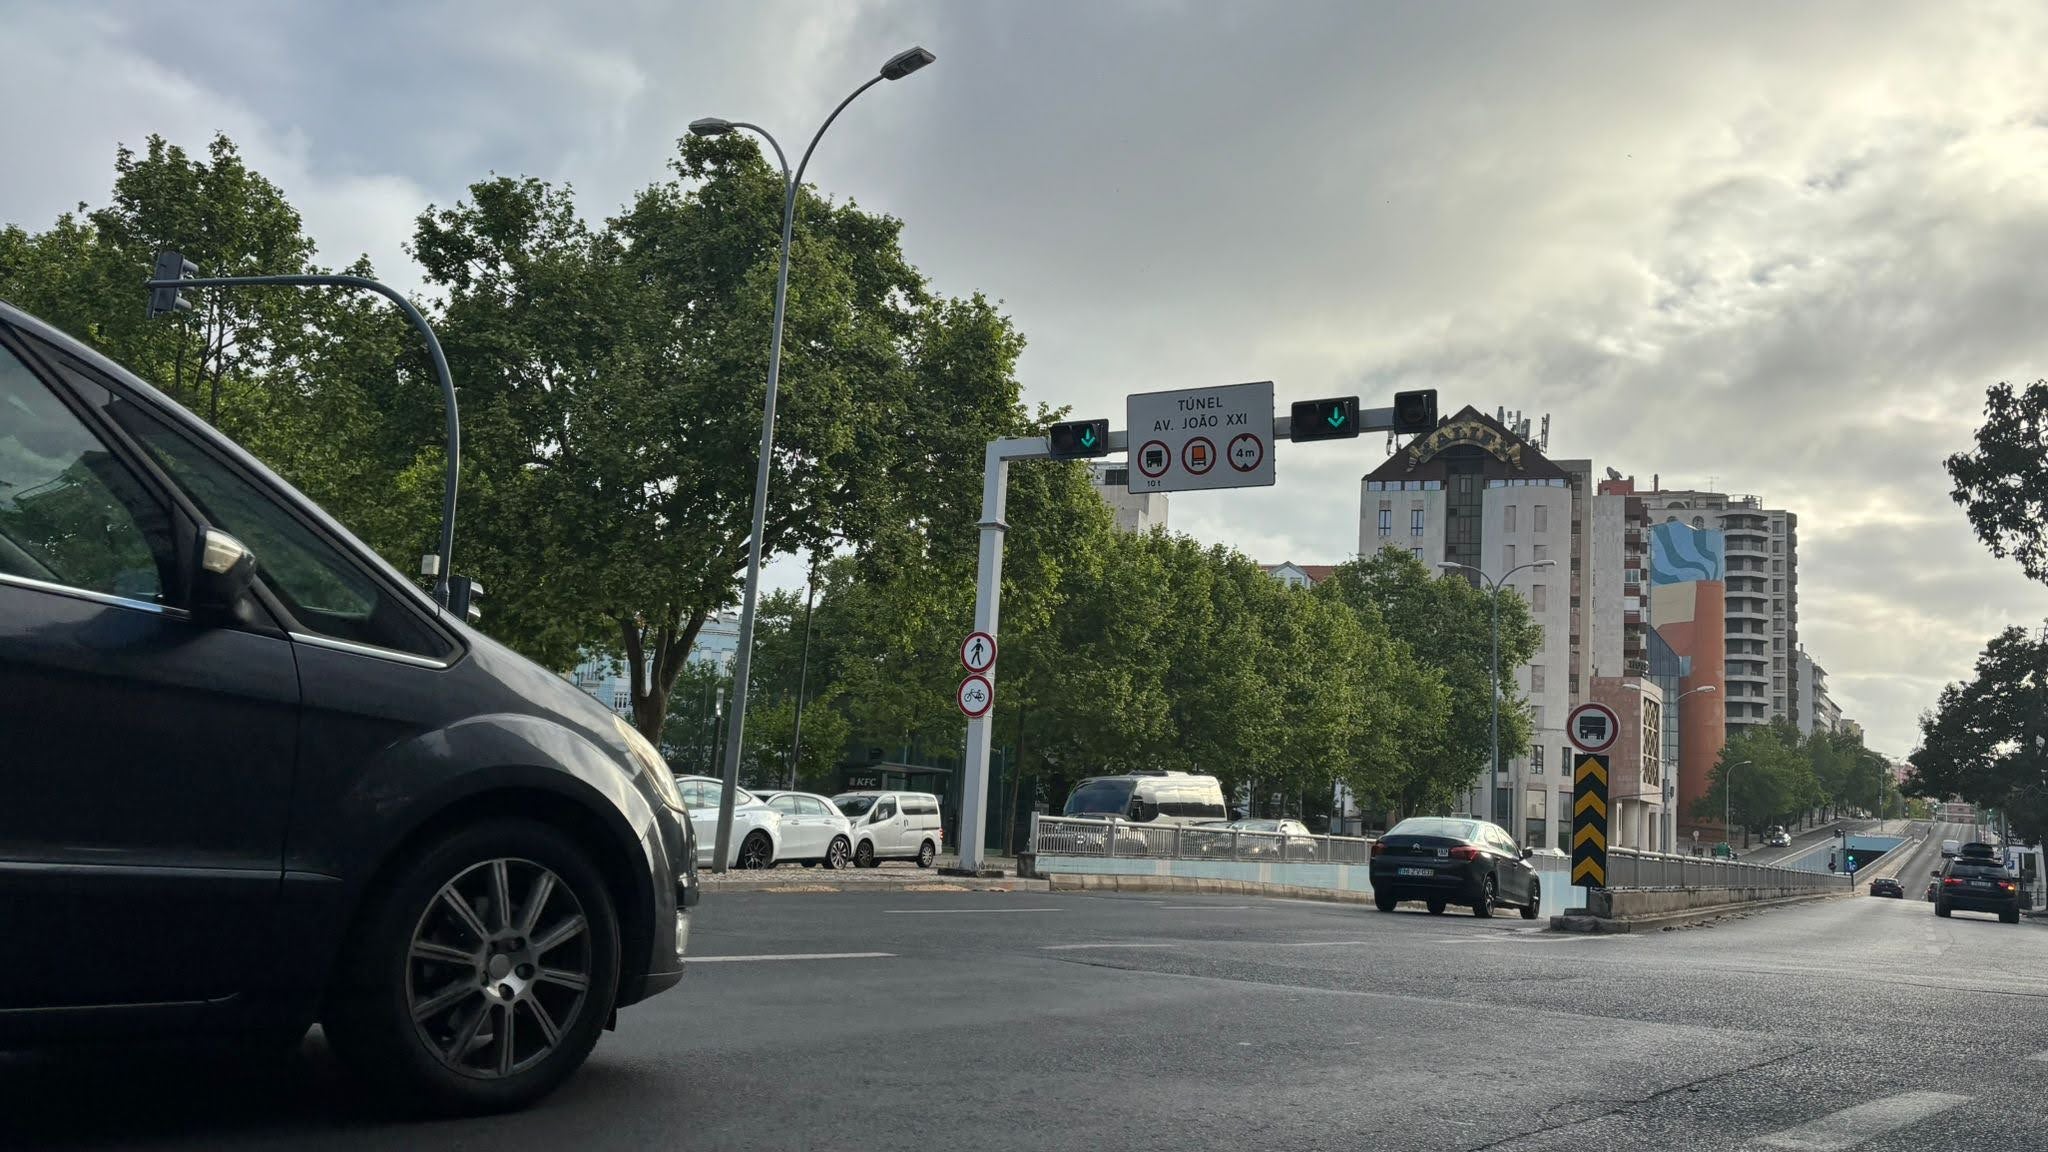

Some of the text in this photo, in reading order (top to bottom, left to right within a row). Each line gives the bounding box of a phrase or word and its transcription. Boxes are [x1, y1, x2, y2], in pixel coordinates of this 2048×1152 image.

[1177, 396, 1223, 412] TÚNEL
[1153, 413, 1247, 432] AV. JOÃO XXI
[857, 777, 877, 786] KFC
